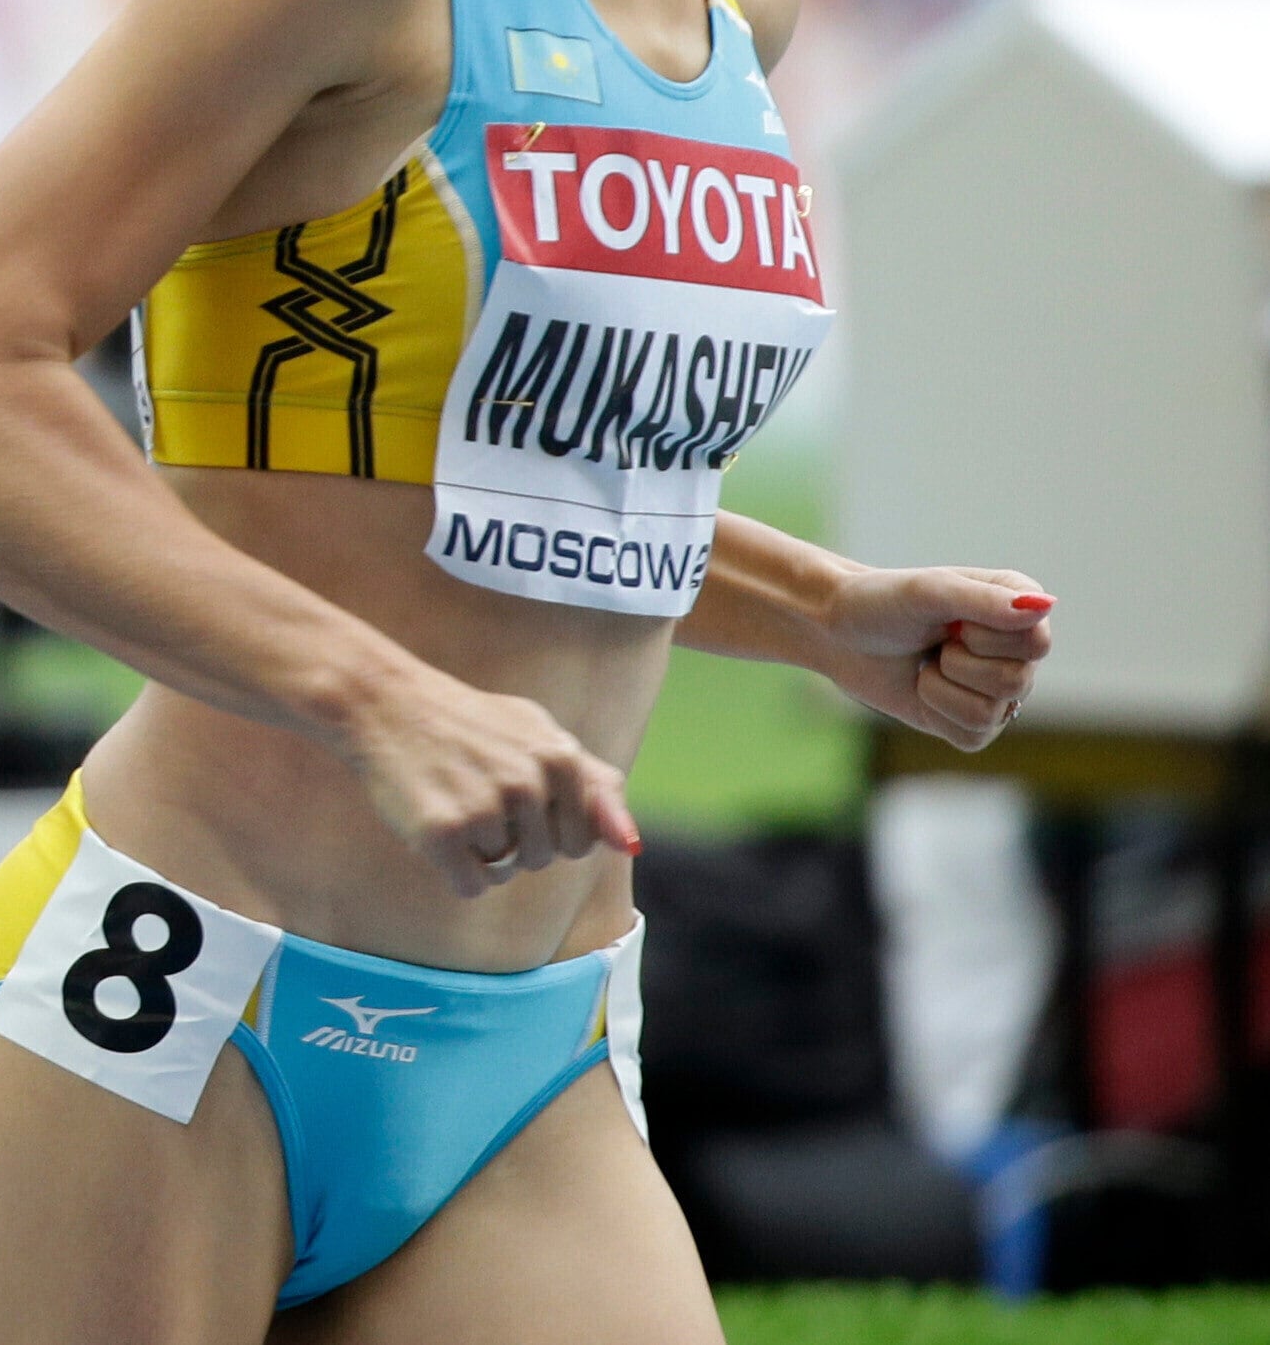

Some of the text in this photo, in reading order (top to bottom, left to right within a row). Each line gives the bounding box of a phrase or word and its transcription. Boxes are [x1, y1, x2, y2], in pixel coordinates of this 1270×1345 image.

[502, 150, 817, 279] TOYOTA
[464, 311, 813, 471] MUKASHEV
[442, 512, 694, 591] MOSCOW
[62, 881, 204, 1054] 8
